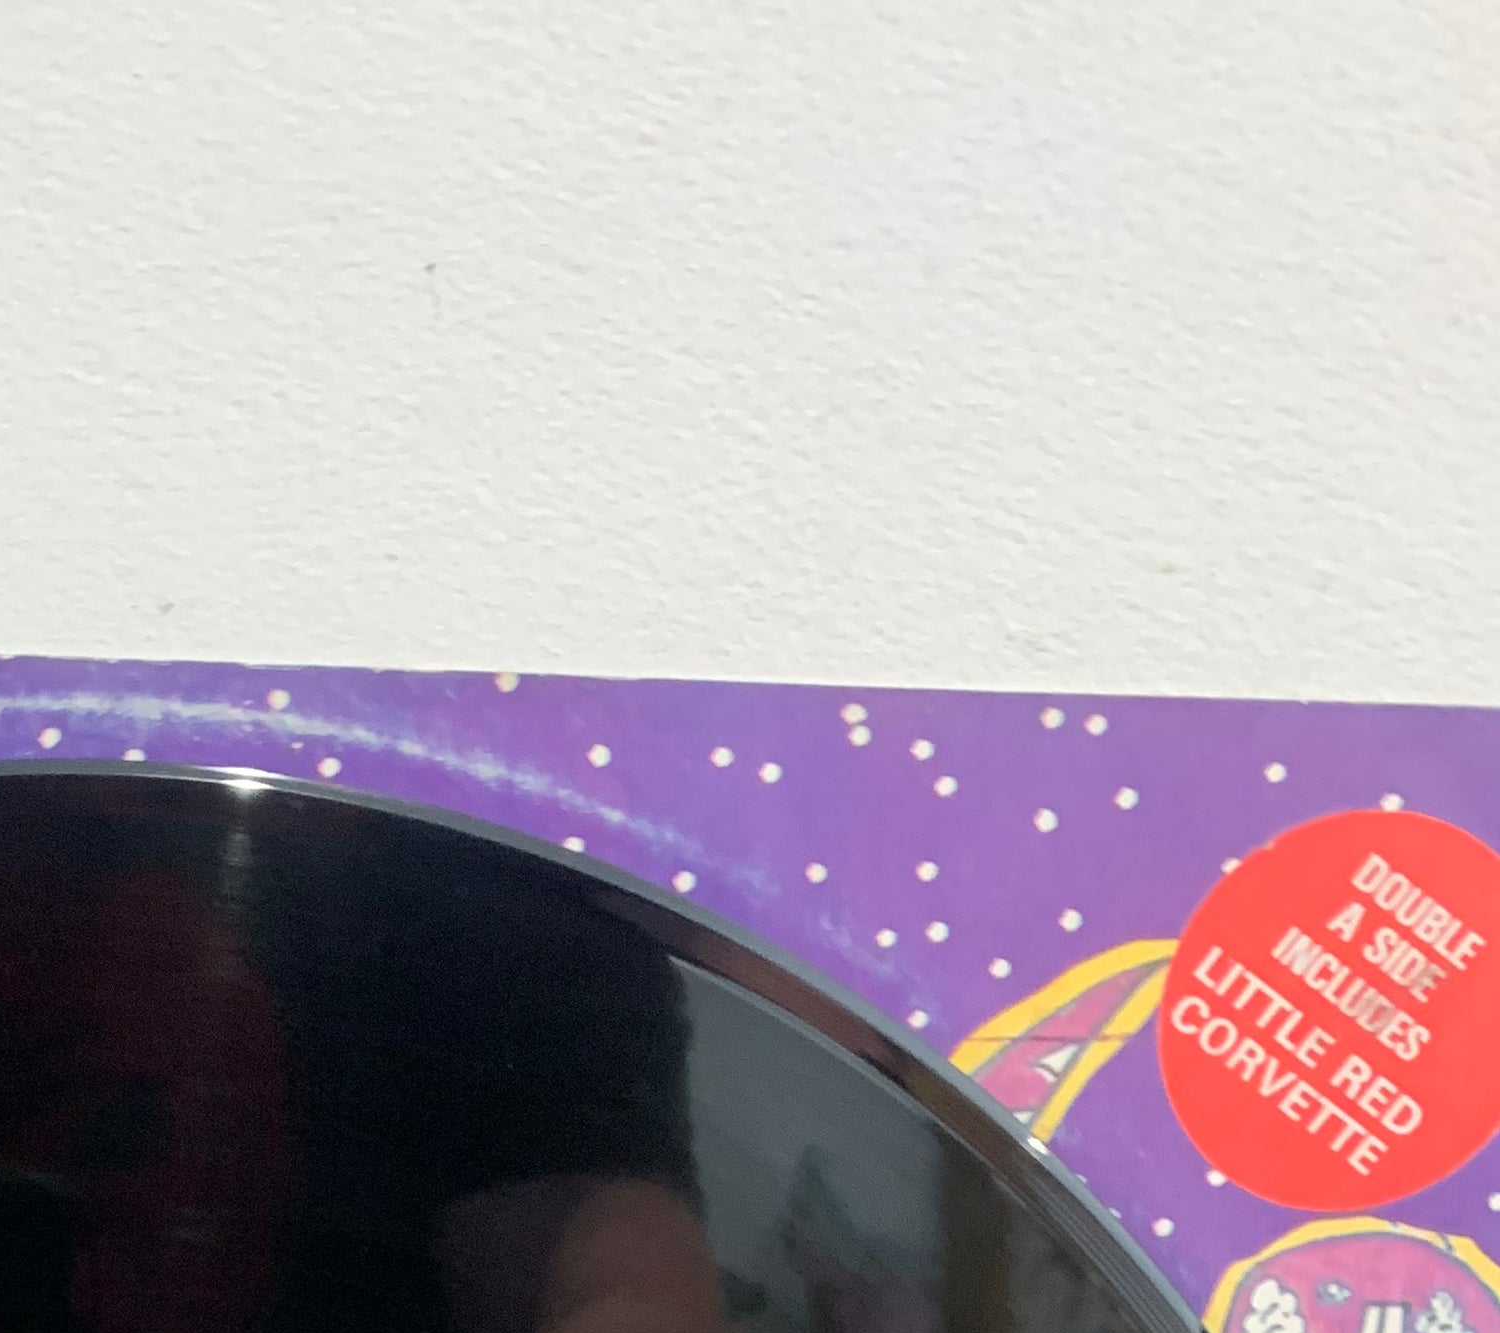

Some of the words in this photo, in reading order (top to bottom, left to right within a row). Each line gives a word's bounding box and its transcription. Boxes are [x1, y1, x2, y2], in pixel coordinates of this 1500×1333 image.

[1327, 903, 1365, 943] A
[1362, 926, 1450, 1003] SIDE
[1351, 853, 1488, 972] DOUBLE
[1194, 947, 1336, 1070] LITTLE
[1330, 1056, 1424, 1136] RED
[1272, 927, 1431, 1061] INCLUDES
[1170, 995, 1389, 1175] CORVETTE
